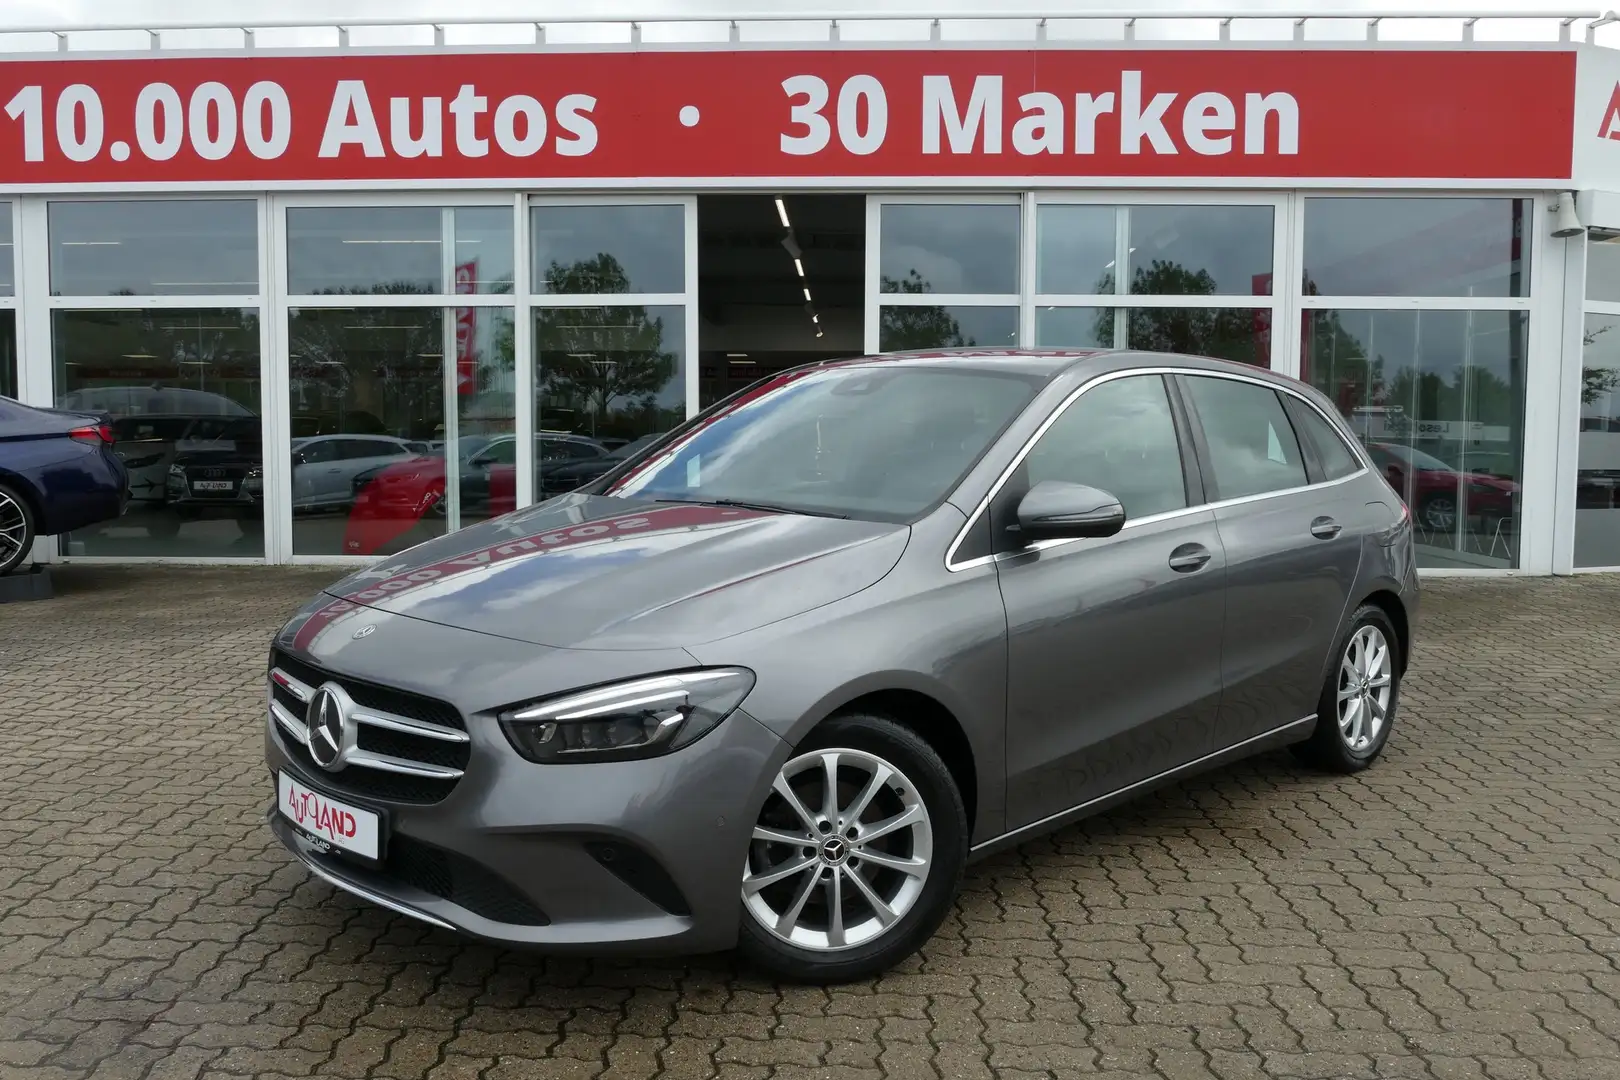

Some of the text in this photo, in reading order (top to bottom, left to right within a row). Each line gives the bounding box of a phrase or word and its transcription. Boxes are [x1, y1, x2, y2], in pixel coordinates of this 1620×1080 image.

[4, 71, 1299, 162] 10.000 Autos 30 Marken
[289, 782, 357, 841] AUTOLAND
